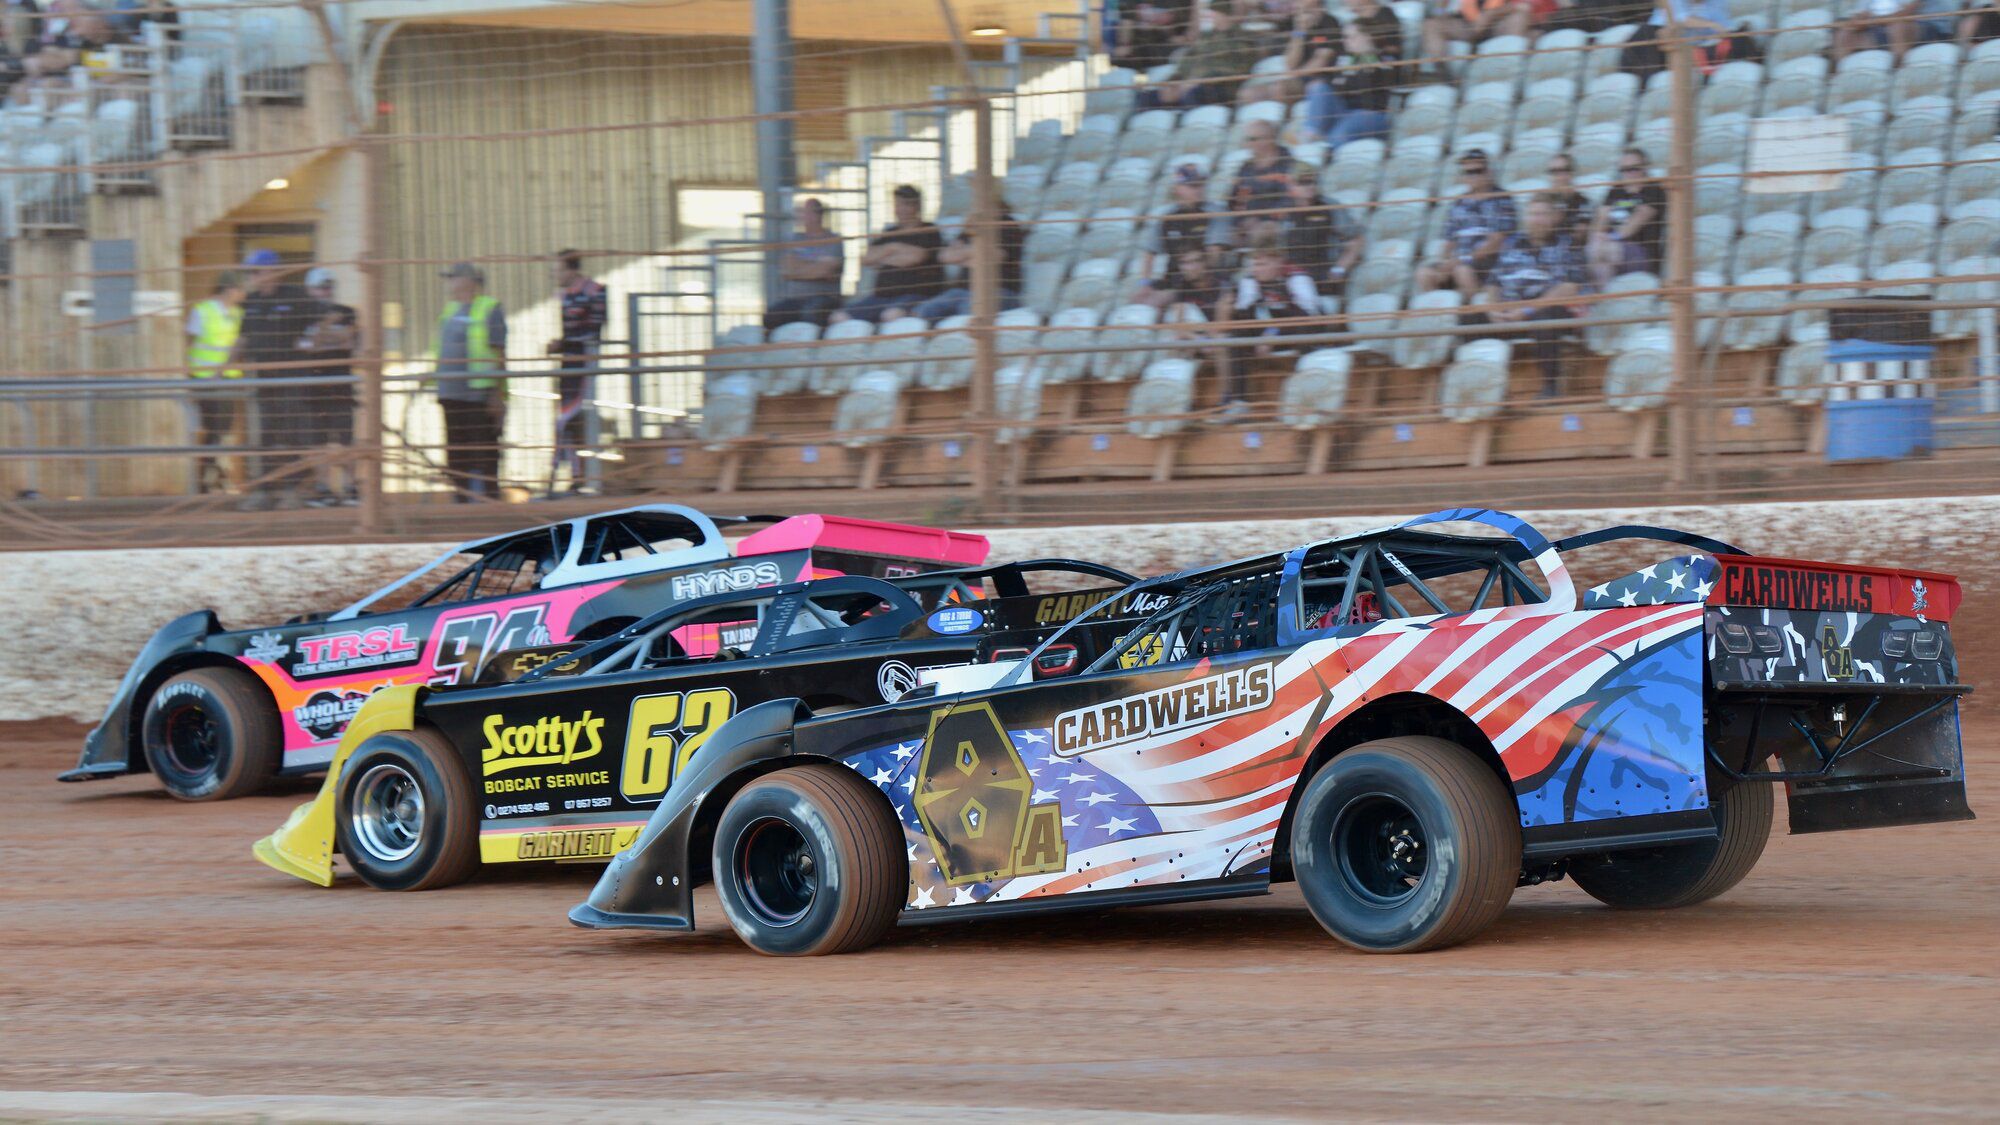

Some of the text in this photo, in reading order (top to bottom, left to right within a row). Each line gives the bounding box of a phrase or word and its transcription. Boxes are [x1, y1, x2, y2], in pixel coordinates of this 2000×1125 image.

[673, 563, 780, 599] HYNDS
[1725, 566, 1872, 612] CARDWELLS
[300, 625, 418, 664] TRSL
[1056, 668, 1272, 751] CARDWELLS
[482, 710, 605, 766] Scotty's
[622, 688, 736, 802] 62
[484, 771, 610, 794] BOBCAT SERVICE
[518, 828, 616, 858] GARNETT
